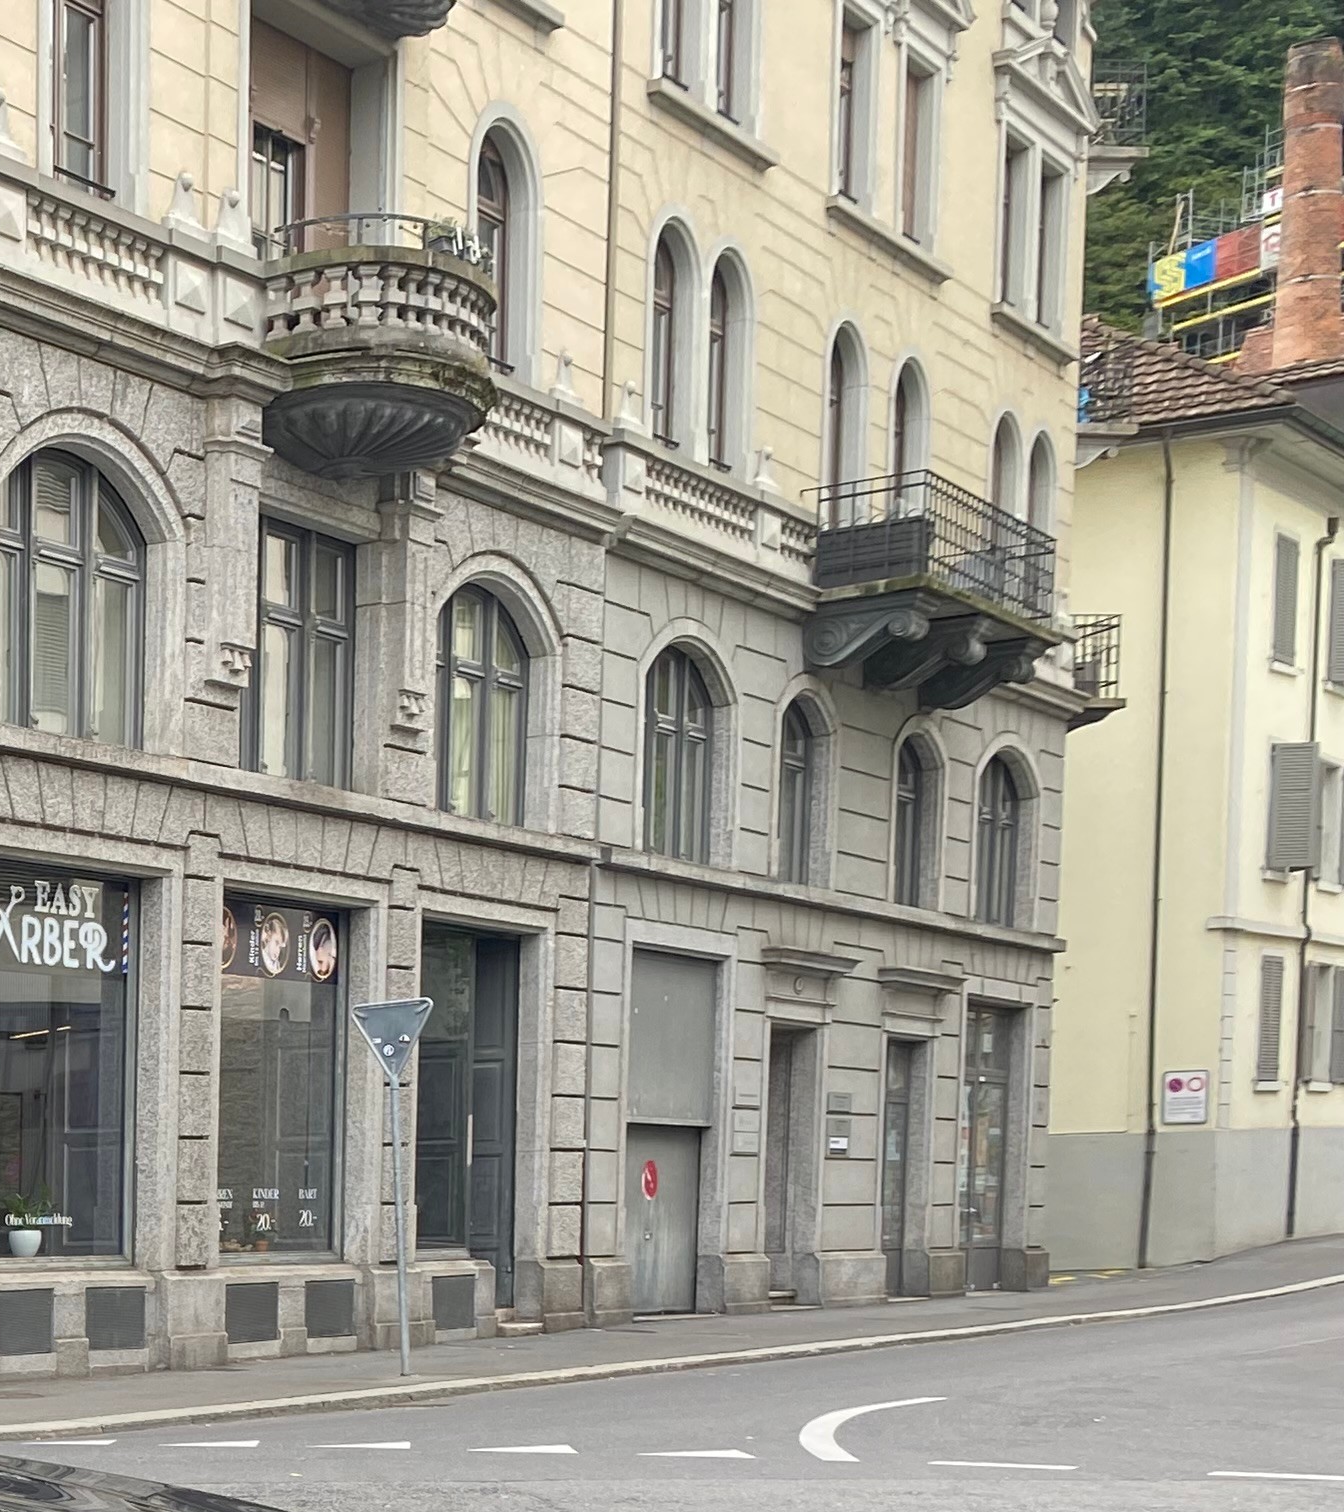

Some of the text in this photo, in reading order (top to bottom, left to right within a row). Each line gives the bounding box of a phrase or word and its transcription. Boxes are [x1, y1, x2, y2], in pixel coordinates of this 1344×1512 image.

[34, 880, 99, 918] EASY
[252, 1188, 280, 1199] KINDER
[298, 1188, 318, 1199] BART
[4, 1213, 24, 1226] Ohne
